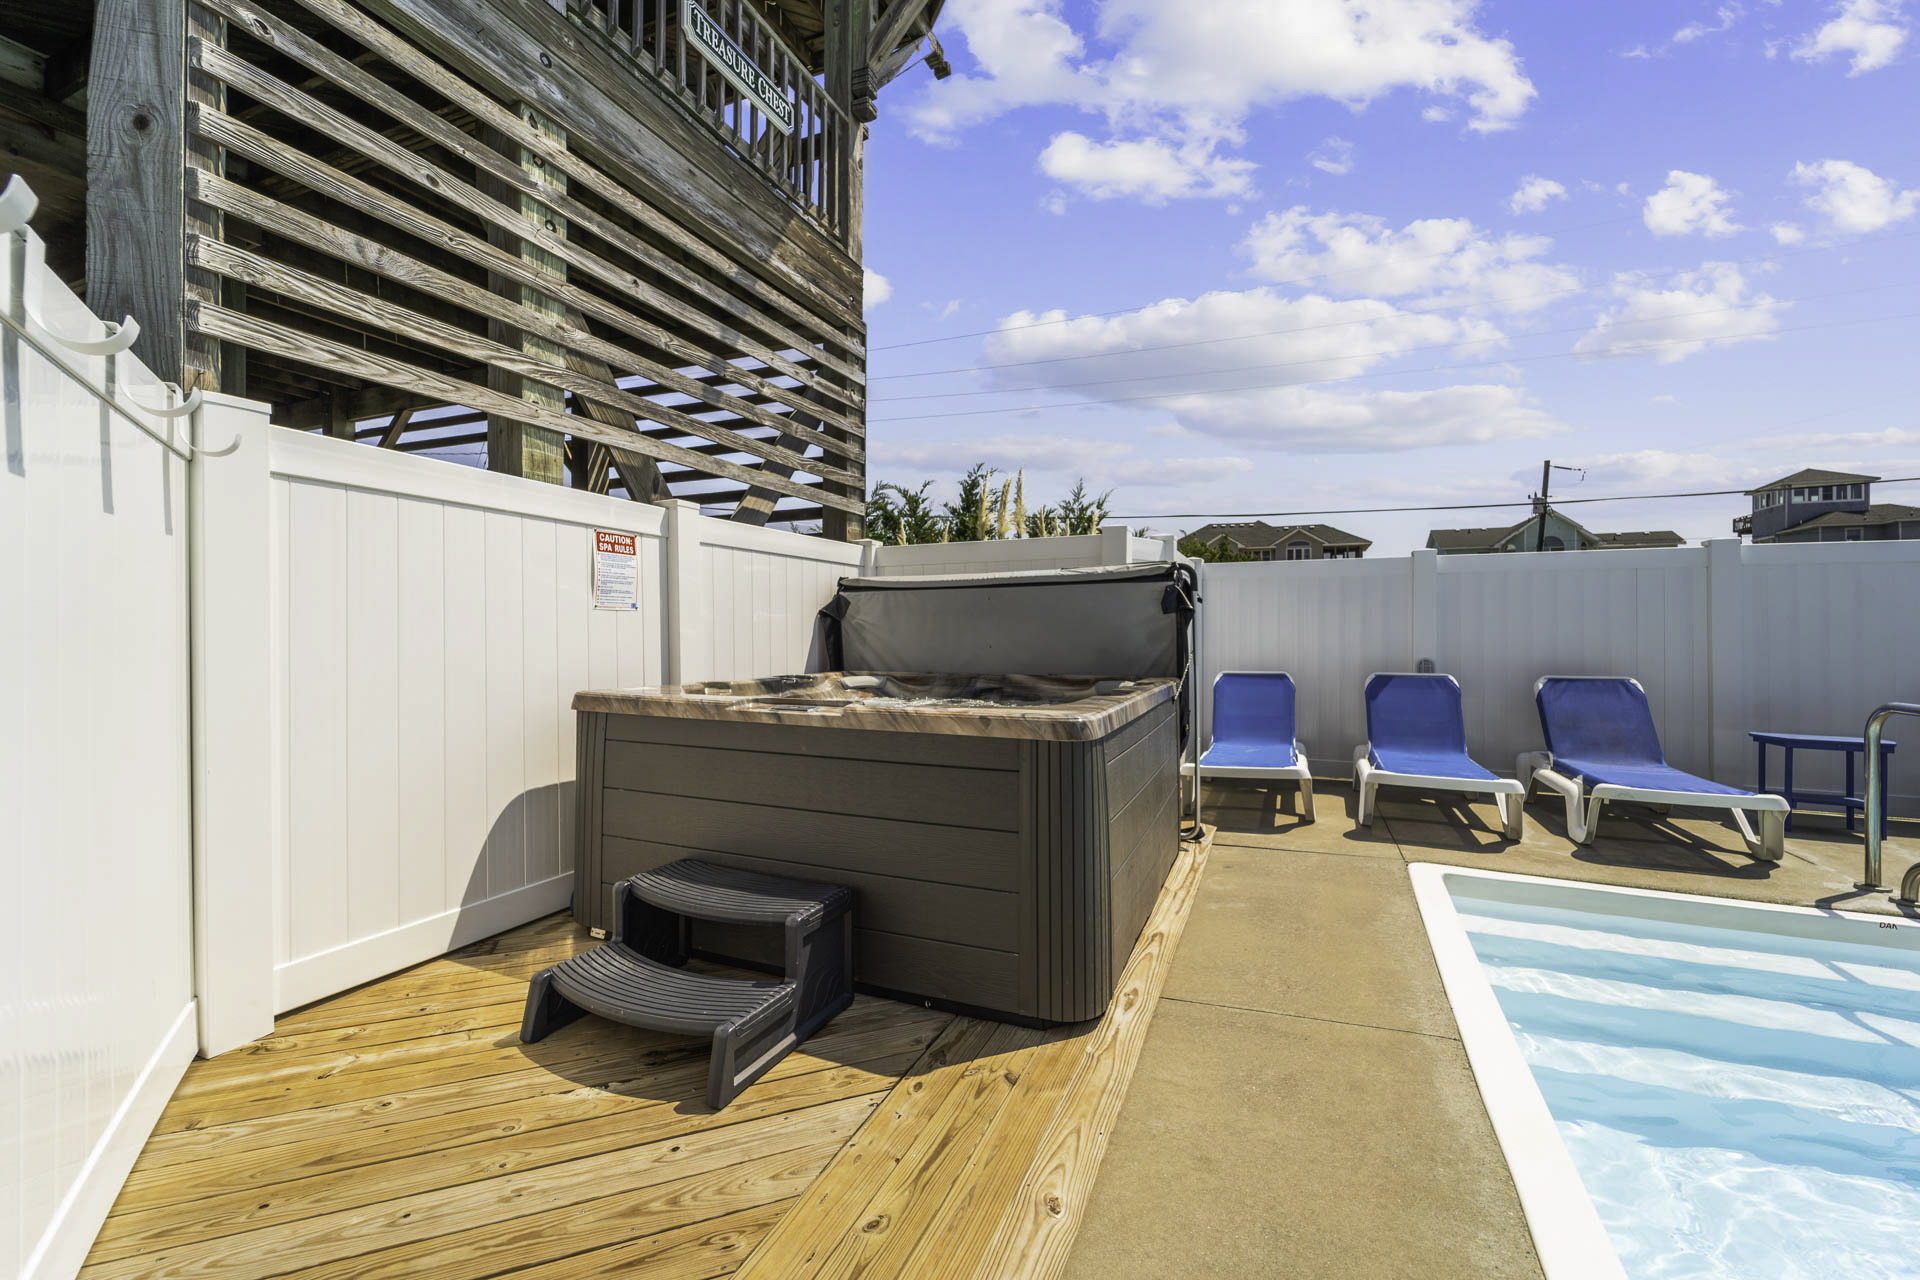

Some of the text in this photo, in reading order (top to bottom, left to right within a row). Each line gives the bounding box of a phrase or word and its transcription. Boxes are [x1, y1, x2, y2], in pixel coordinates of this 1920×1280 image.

[693, 9, 791, 122] TREASURE CHEST
[599, 533, 633, 545] CAUTION:
[599, 542, 634, 554] SPA RULES
